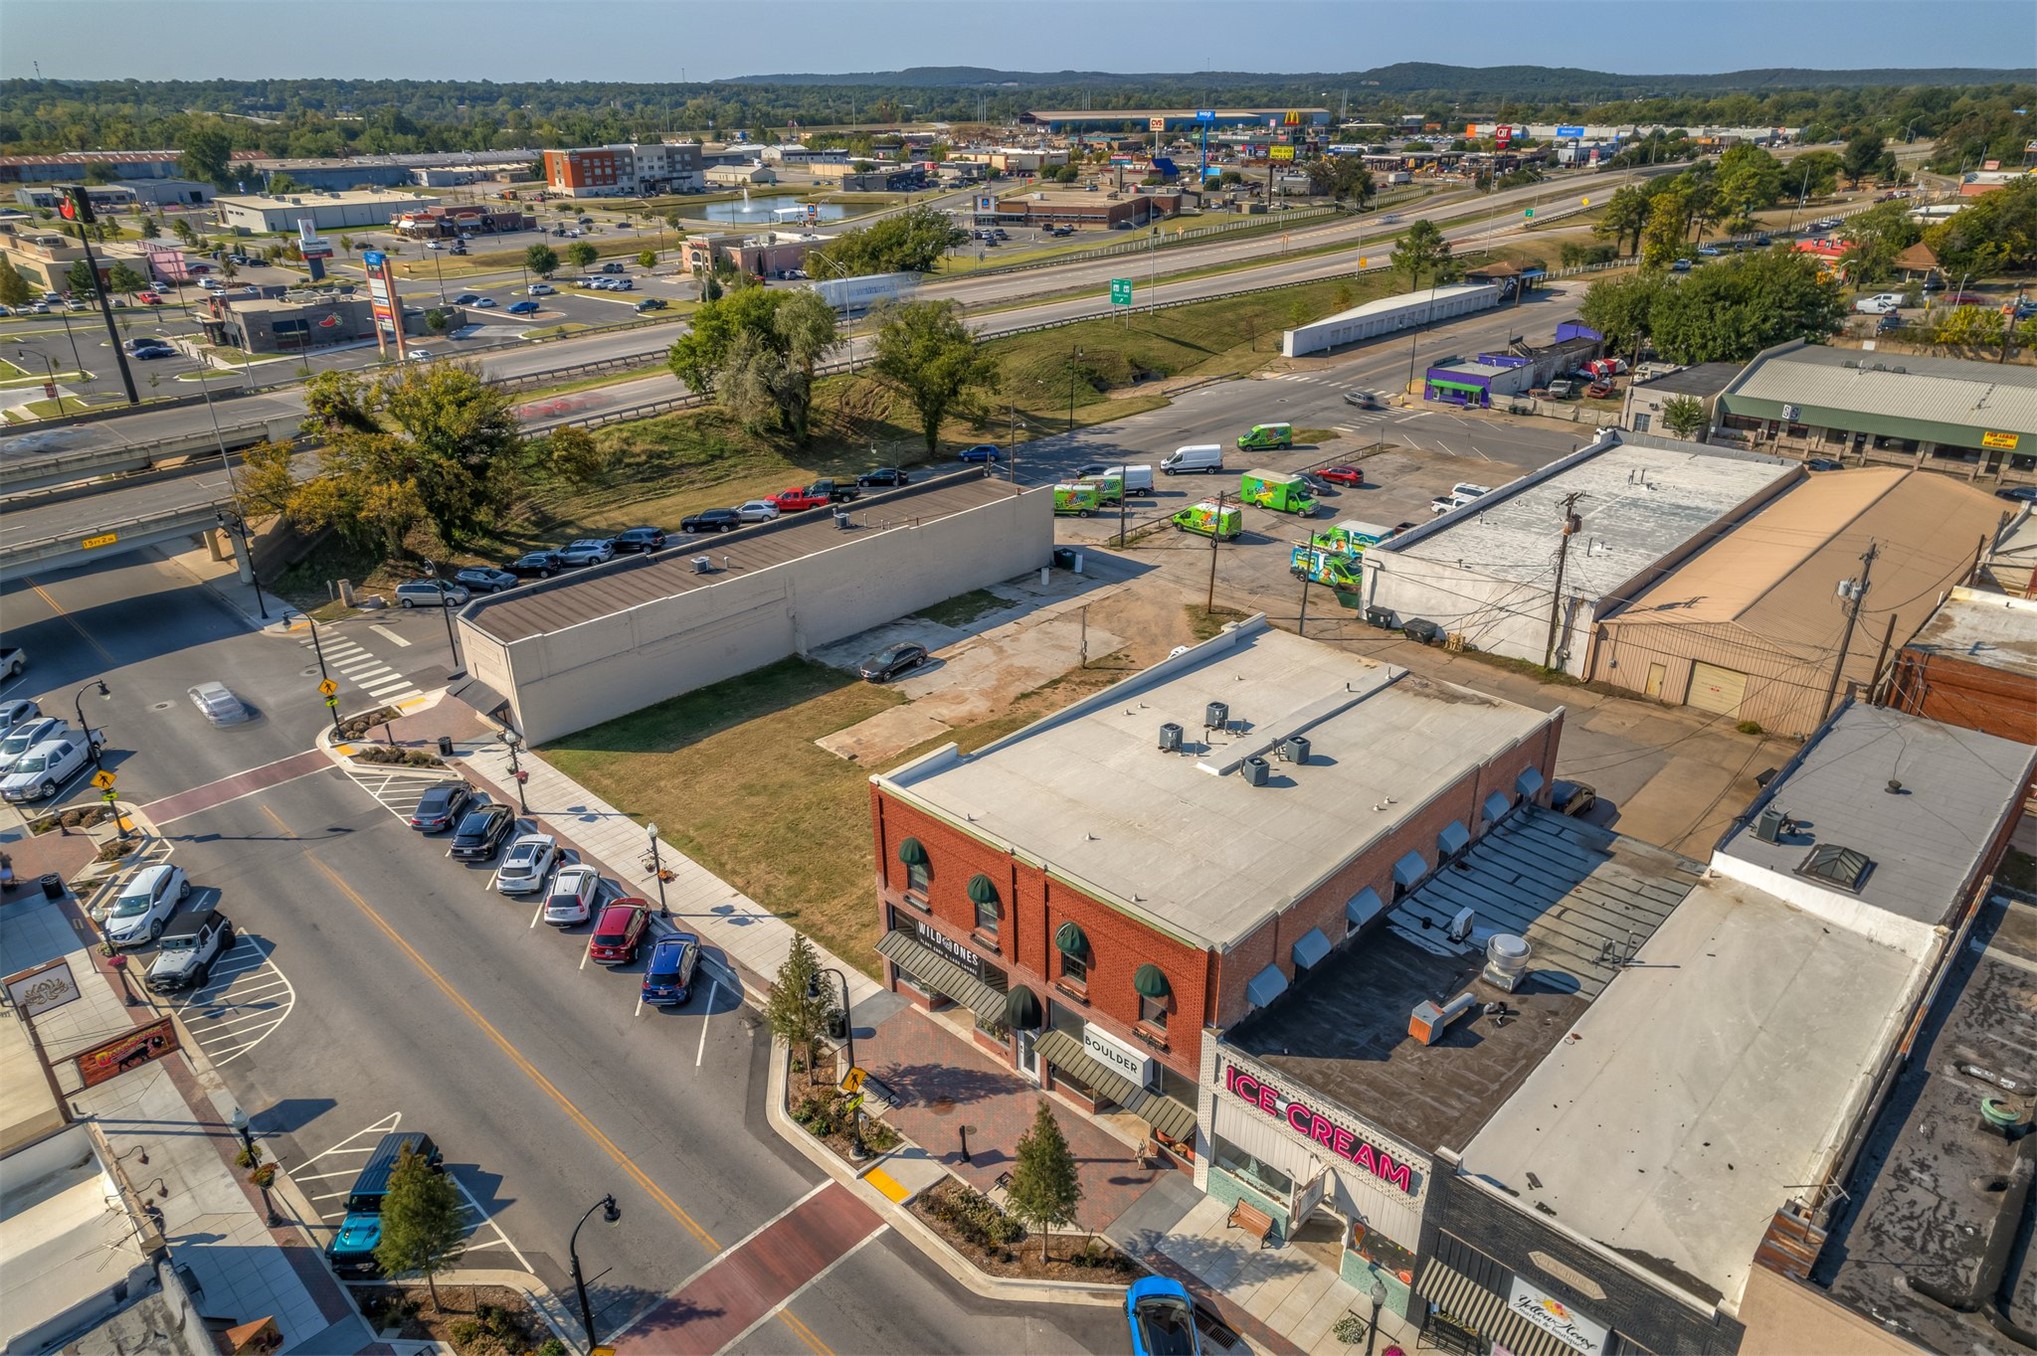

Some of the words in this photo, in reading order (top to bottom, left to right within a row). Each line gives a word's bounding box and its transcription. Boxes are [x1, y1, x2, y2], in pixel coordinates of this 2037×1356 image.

[1151, 119, 1163, 127] CVS
[1497, 128, 1509, 138] QT
[918, 920, 942, 944] WILD
[953, 943, 979, 966] ONES
[1085, 1035, 1138, 1074] BOULDER
[1226, 1065, 1280, 1118] ICE
[1286, 1102, 1412, 1193] CREAM
[1514, 1294, 1557, 1325] Yellow
[1558, 1323, 1598, 1350] House
[1518, 1307, 1541, 1323] market
[1552, 1327, 1582, 1347] boutique
